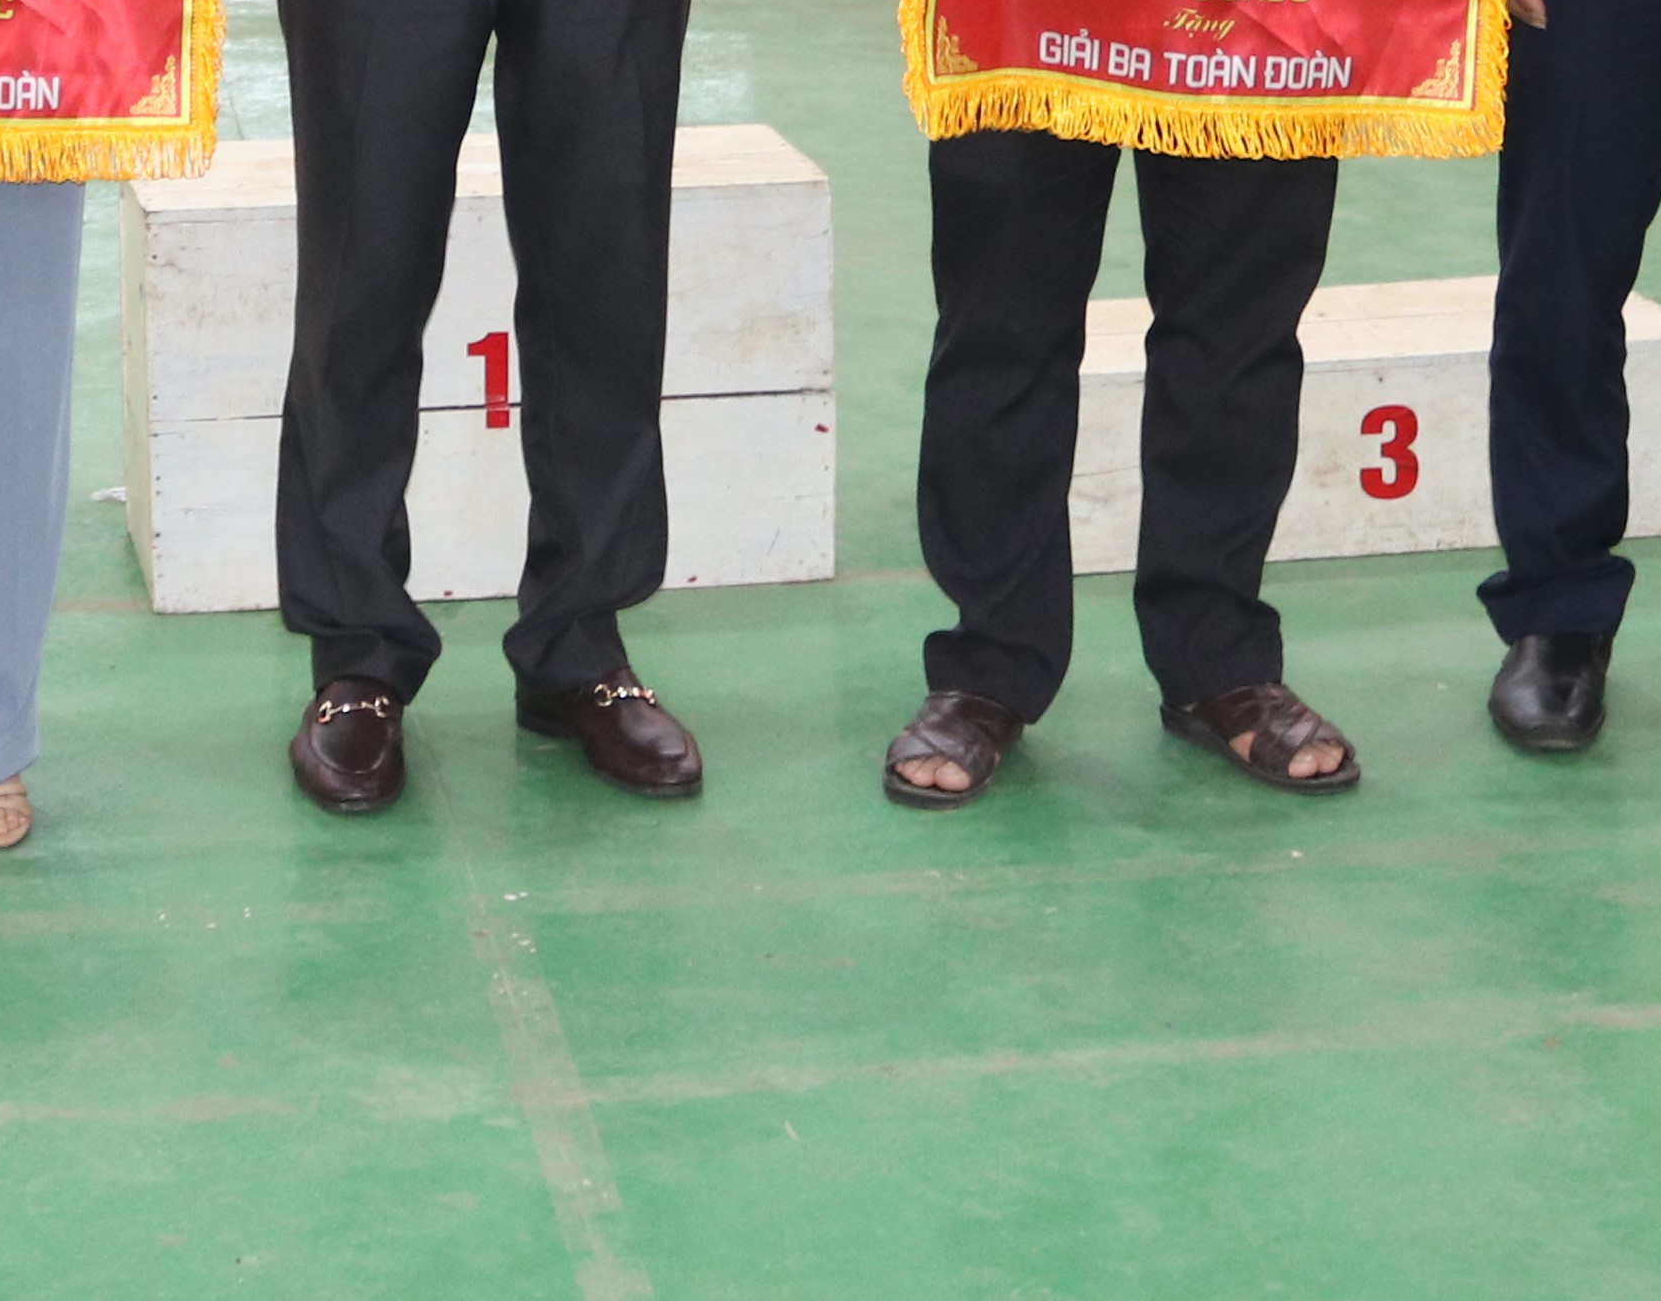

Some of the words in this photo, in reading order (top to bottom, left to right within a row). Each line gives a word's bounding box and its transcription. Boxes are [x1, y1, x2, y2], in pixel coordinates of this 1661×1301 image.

[1039, 28, 1100, 71] GIẢI
[1108, 41, 1152, 81] BA
[1164, 48, 1256, 89] TOÀN
[1263, 50, 1352, 89] ĐOÀN
[1164, 8, 1236, 40] Tặng
[467, 332, 509, 428] 1
[1360, 404, 1419, 499] 3
